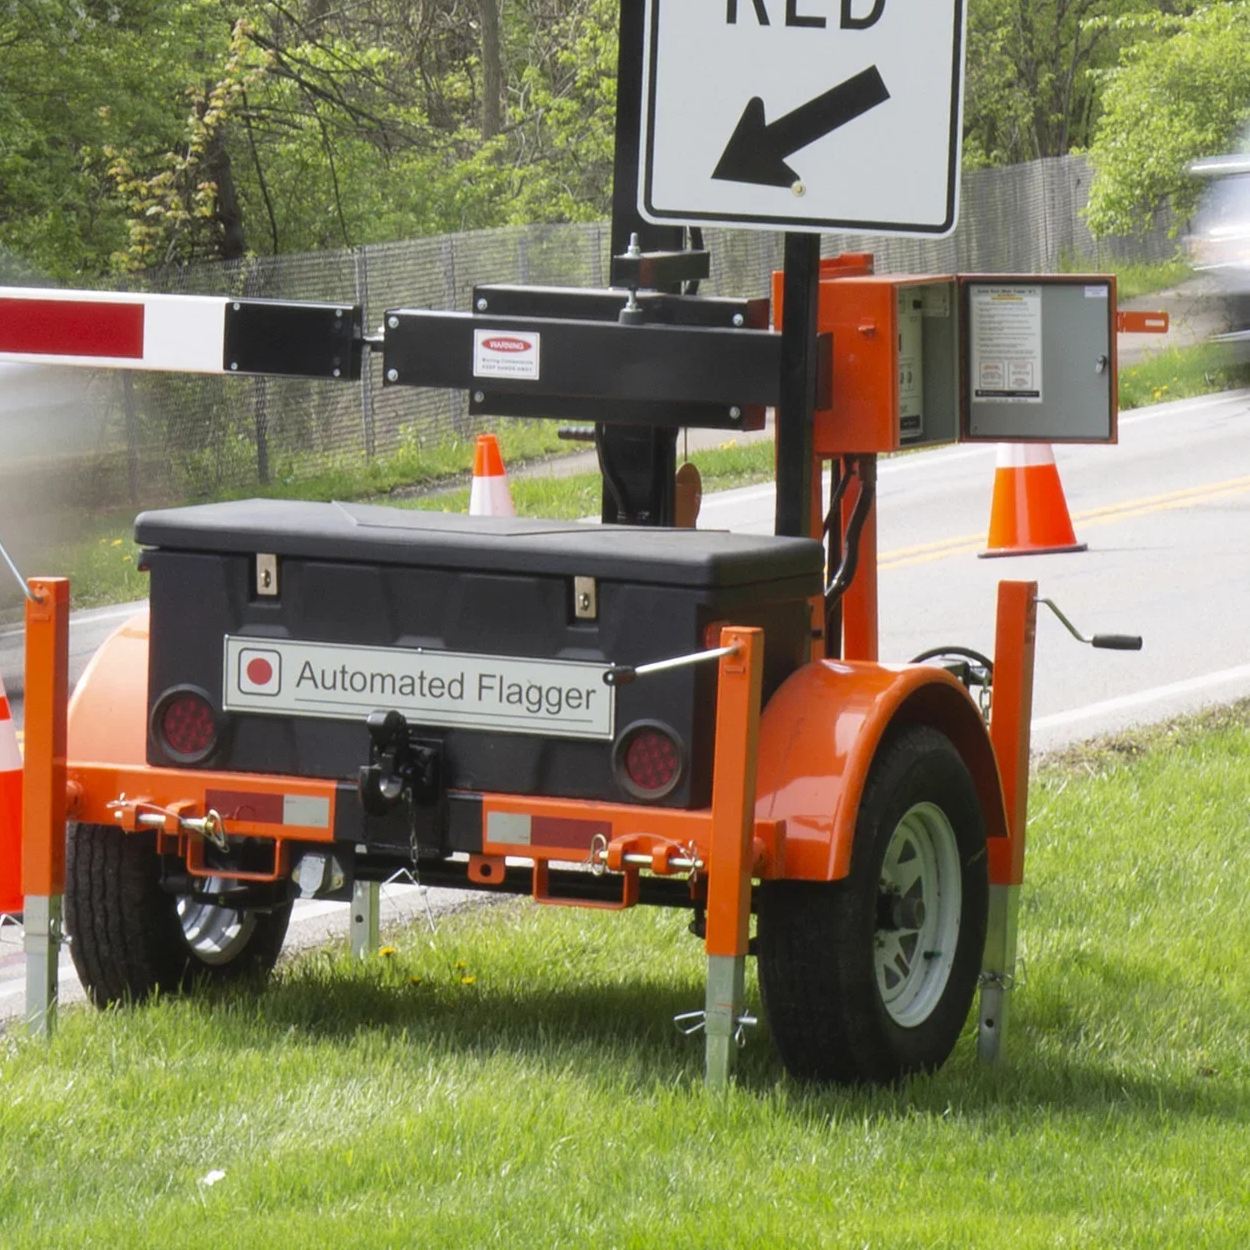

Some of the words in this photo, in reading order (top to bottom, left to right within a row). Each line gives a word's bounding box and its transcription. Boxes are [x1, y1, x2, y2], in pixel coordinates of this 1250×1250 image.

[489, 340, 524, 350] WARNING
[295, 660, 465, 701] Automated
[477, 673, 597, 715] Flagger
